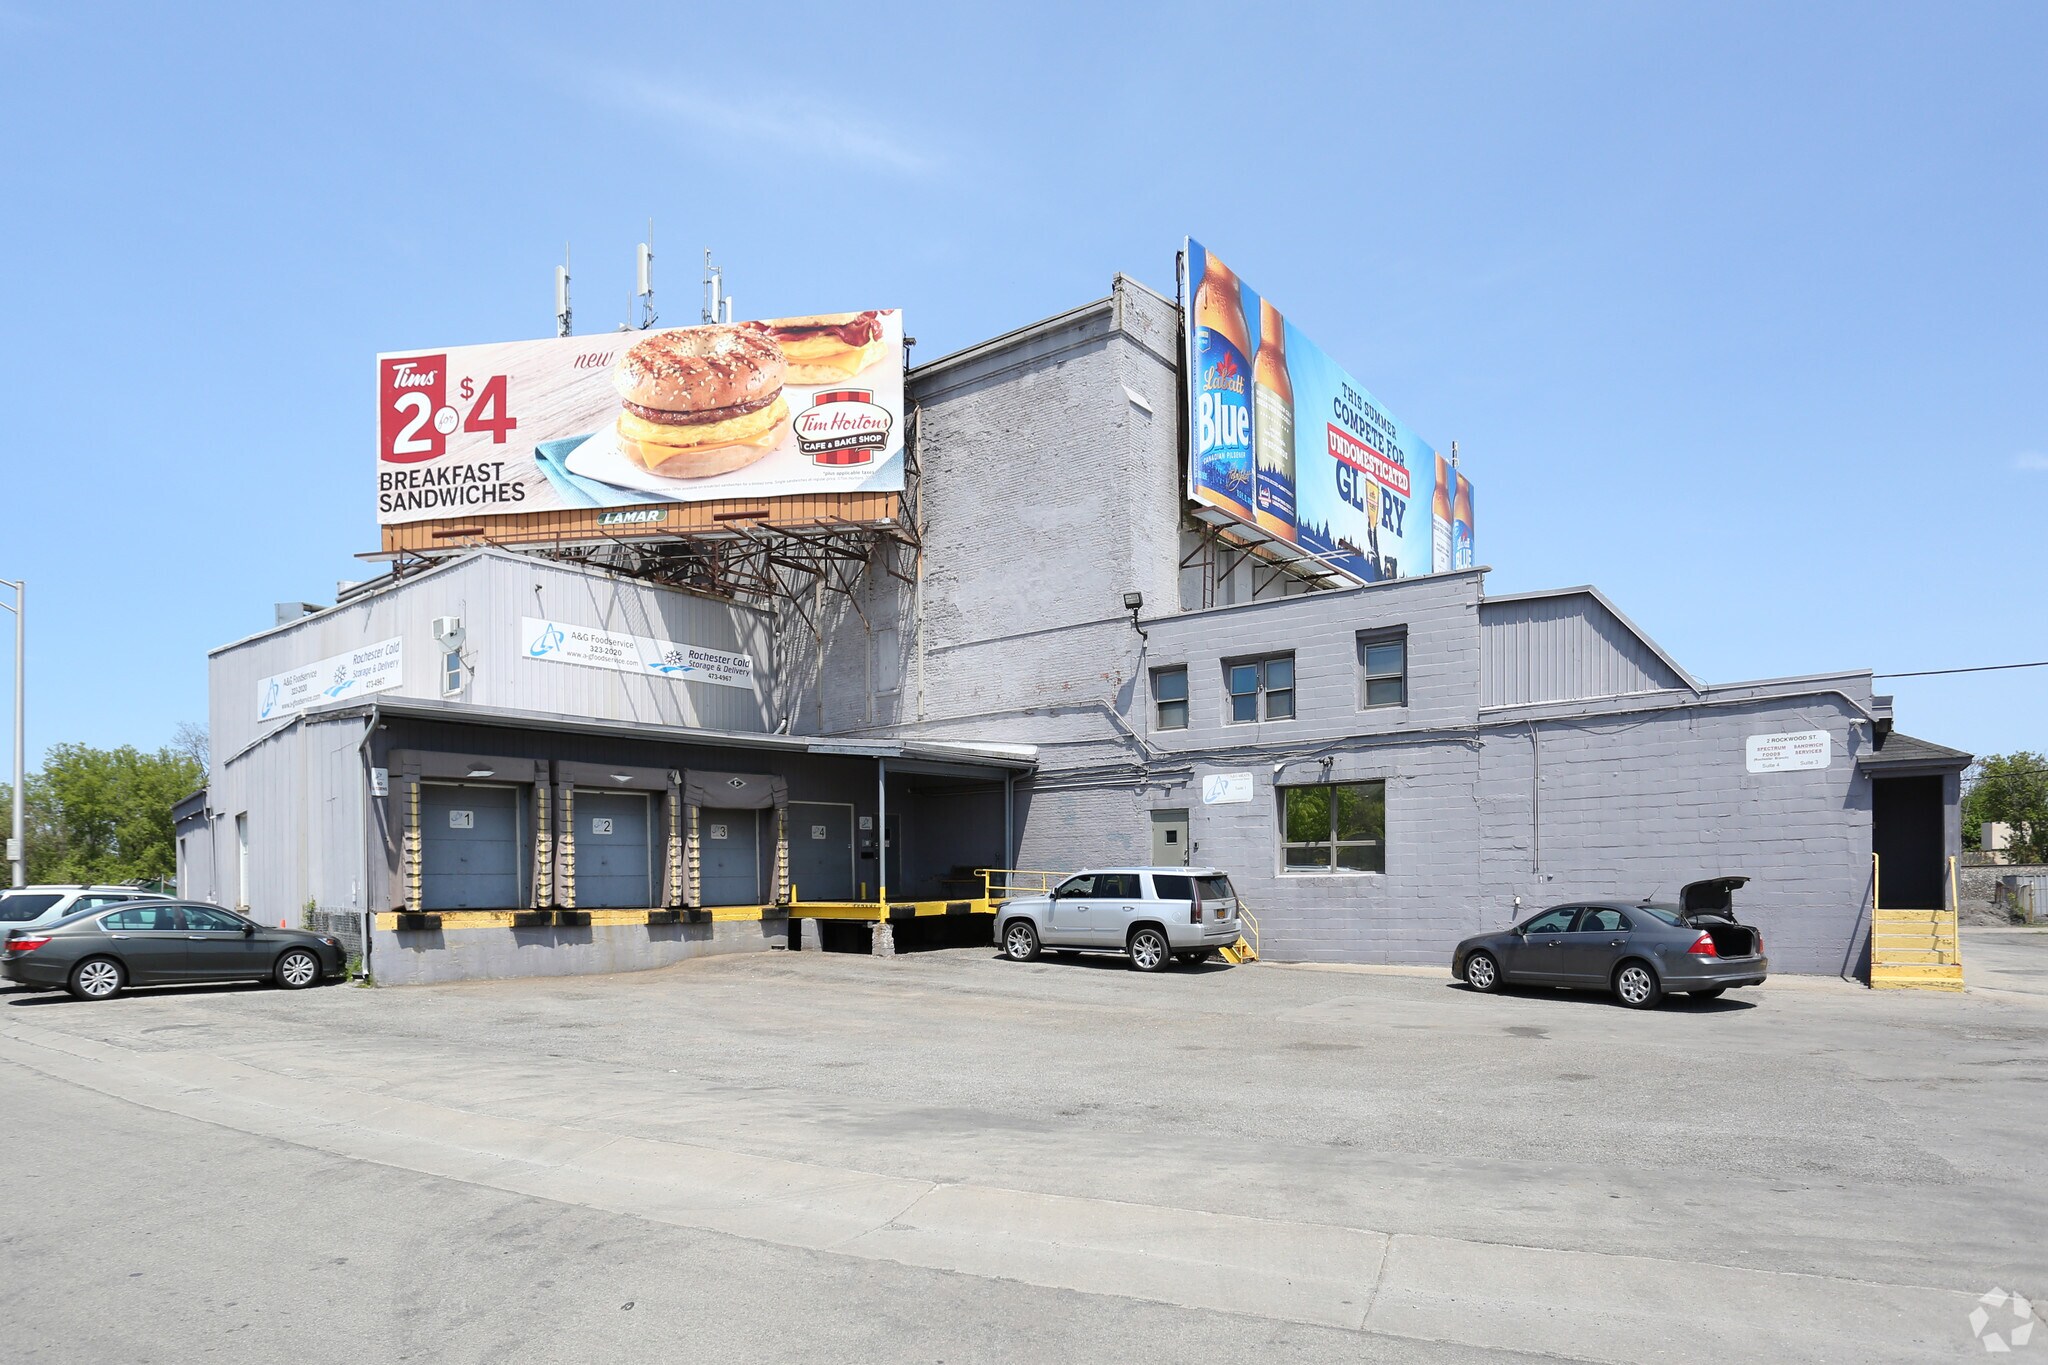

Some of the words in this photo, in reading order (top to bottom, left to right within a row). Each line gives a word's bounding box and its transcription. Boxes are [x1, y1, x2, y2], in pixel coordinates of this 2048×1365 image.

[574, 351, 614, 369] new
[1203, 366, 1245, 394] Labatt
[1341, 382, 1363, 411] THIS
[1364, 401, 1397, 440] SUMMER
[393, 391, 432, 454] 2
[438, 413, 454, 430] for
[801, 413, 827, 432] Tim
[830, 411, 888, 431] Hortons
[1198, 392, 1250, 454] Blue
[1333, 396, 1385, 454] COMPETE
[1386, 438, 1405, 469] FOR
[803, 442, 826, 451] CAFE
[834, 436, 857, 447] BAKE
[858, 434, 882, 443] SHOP
[1329, 430, 1409, 492] UNDOMESTICATED
[380, 462, 505, 492] BREAKFAST
[380, 482, 525, 513] SANDWICHES
[603, 510, 659, 524] LAMAR
[571, 631, 589, 642] A&G
[591, 634, 634, 649] Foodservice
[353, 647, 384, 665] Rochester
[385, 641, 400, 656] Cold
[590, 645, 622, 656] 323-2020
[688, 649, 731, 665] Rochester
[733, 657, 750, 668] Cold
[293, 670, 317, 683] Foodservice
[352, 667, 371, 678] Storage
[372, 665, 377, 674] &
[377, 659, 400, 672] Delivery
[688, 660, 715, 671] Storage
[716, 664, 721, 672] &
[723, 665, 750, 677] Delivery
[708, 673, 732, 681] 473-4967
[1771, 735, 1807, 743] ROCKWOOD
[464, 813, 470, 826] 1
[603, 820, 611, 833] 2
[719, 826, 726, 838] 3
[819, 827, 825, 838] 4
